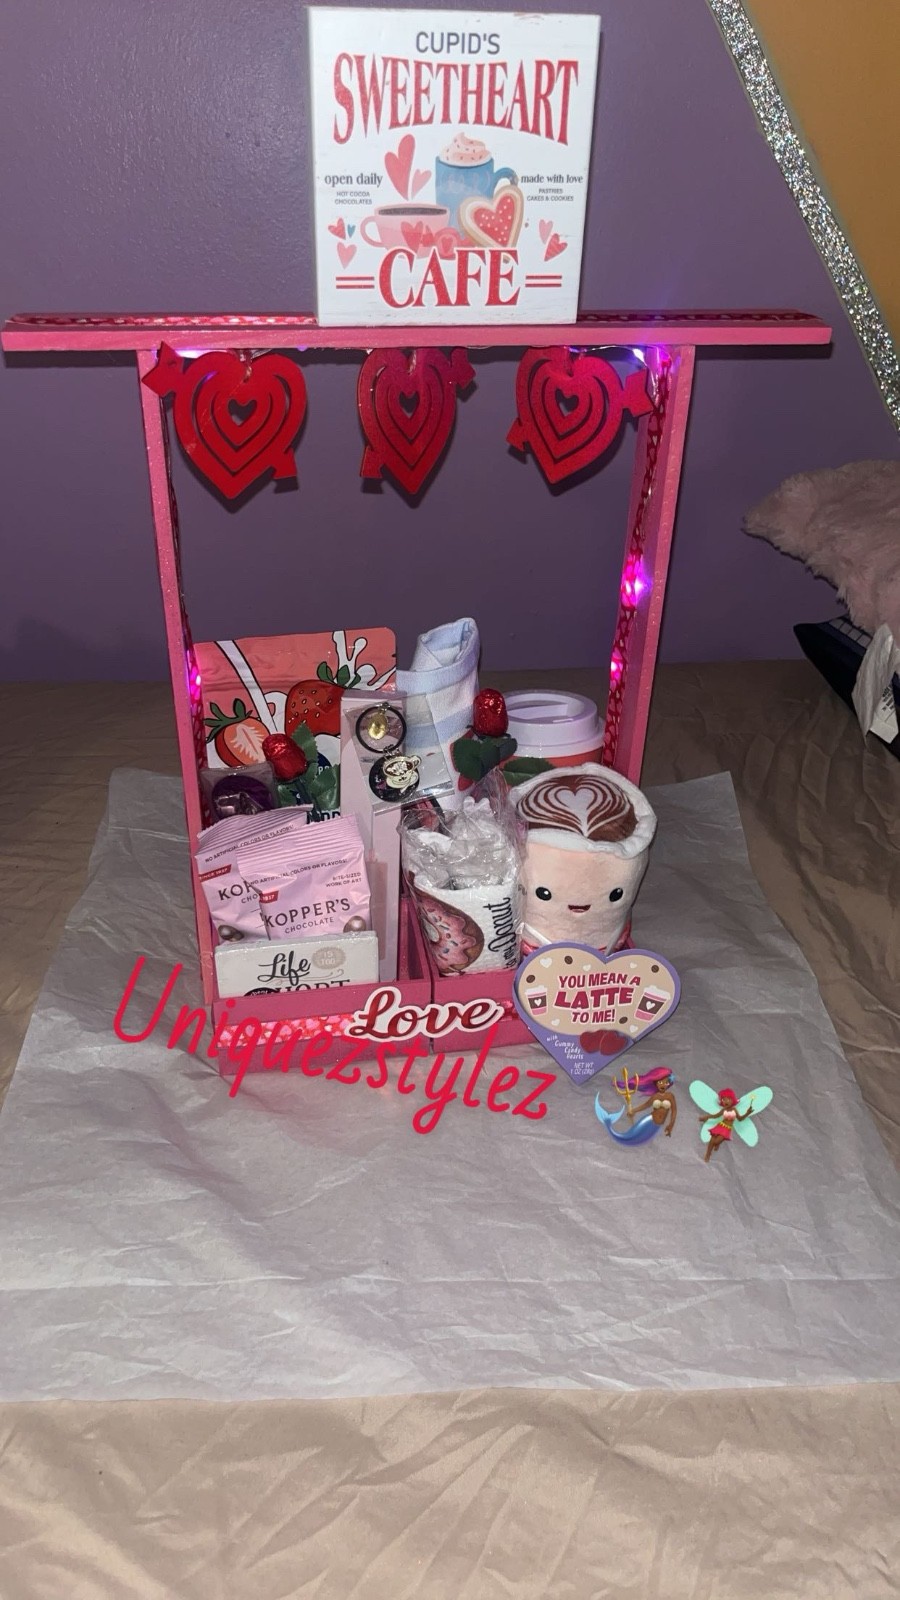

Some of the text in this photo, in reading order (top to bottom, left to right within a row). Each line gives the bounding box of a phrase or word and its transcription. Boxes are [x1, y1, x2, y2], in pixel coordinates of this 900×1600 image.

[416, 31, 500, 55] CUPID'S
[333, 52, 579, 146] SWEETHEART
[324, 172, 383, 188] open daily
[521, 174, 583, 183] made with love
[378, 248, 521, 308] CAFE
[213, 845, 239, 858] ARTIFICIAL
[240, 836, 261, 847] COLORS
[261, 833, 269, 841] OR
[290, 865, 312, 875] COLORS
[264, 897, 351, 928] KOPPER'S
[482, 897, 517, 952] Donut
[284, 916, 335, 934] CHOCOLATE
[257, 950, 311, 986] Life
[558, 972, 641, 988] YOU MEAN A
[554, 987, 635, 1010] LATTE
[349, 990, 499, 1039] Love
[571, 1009, 616, 1023] TO ME!
